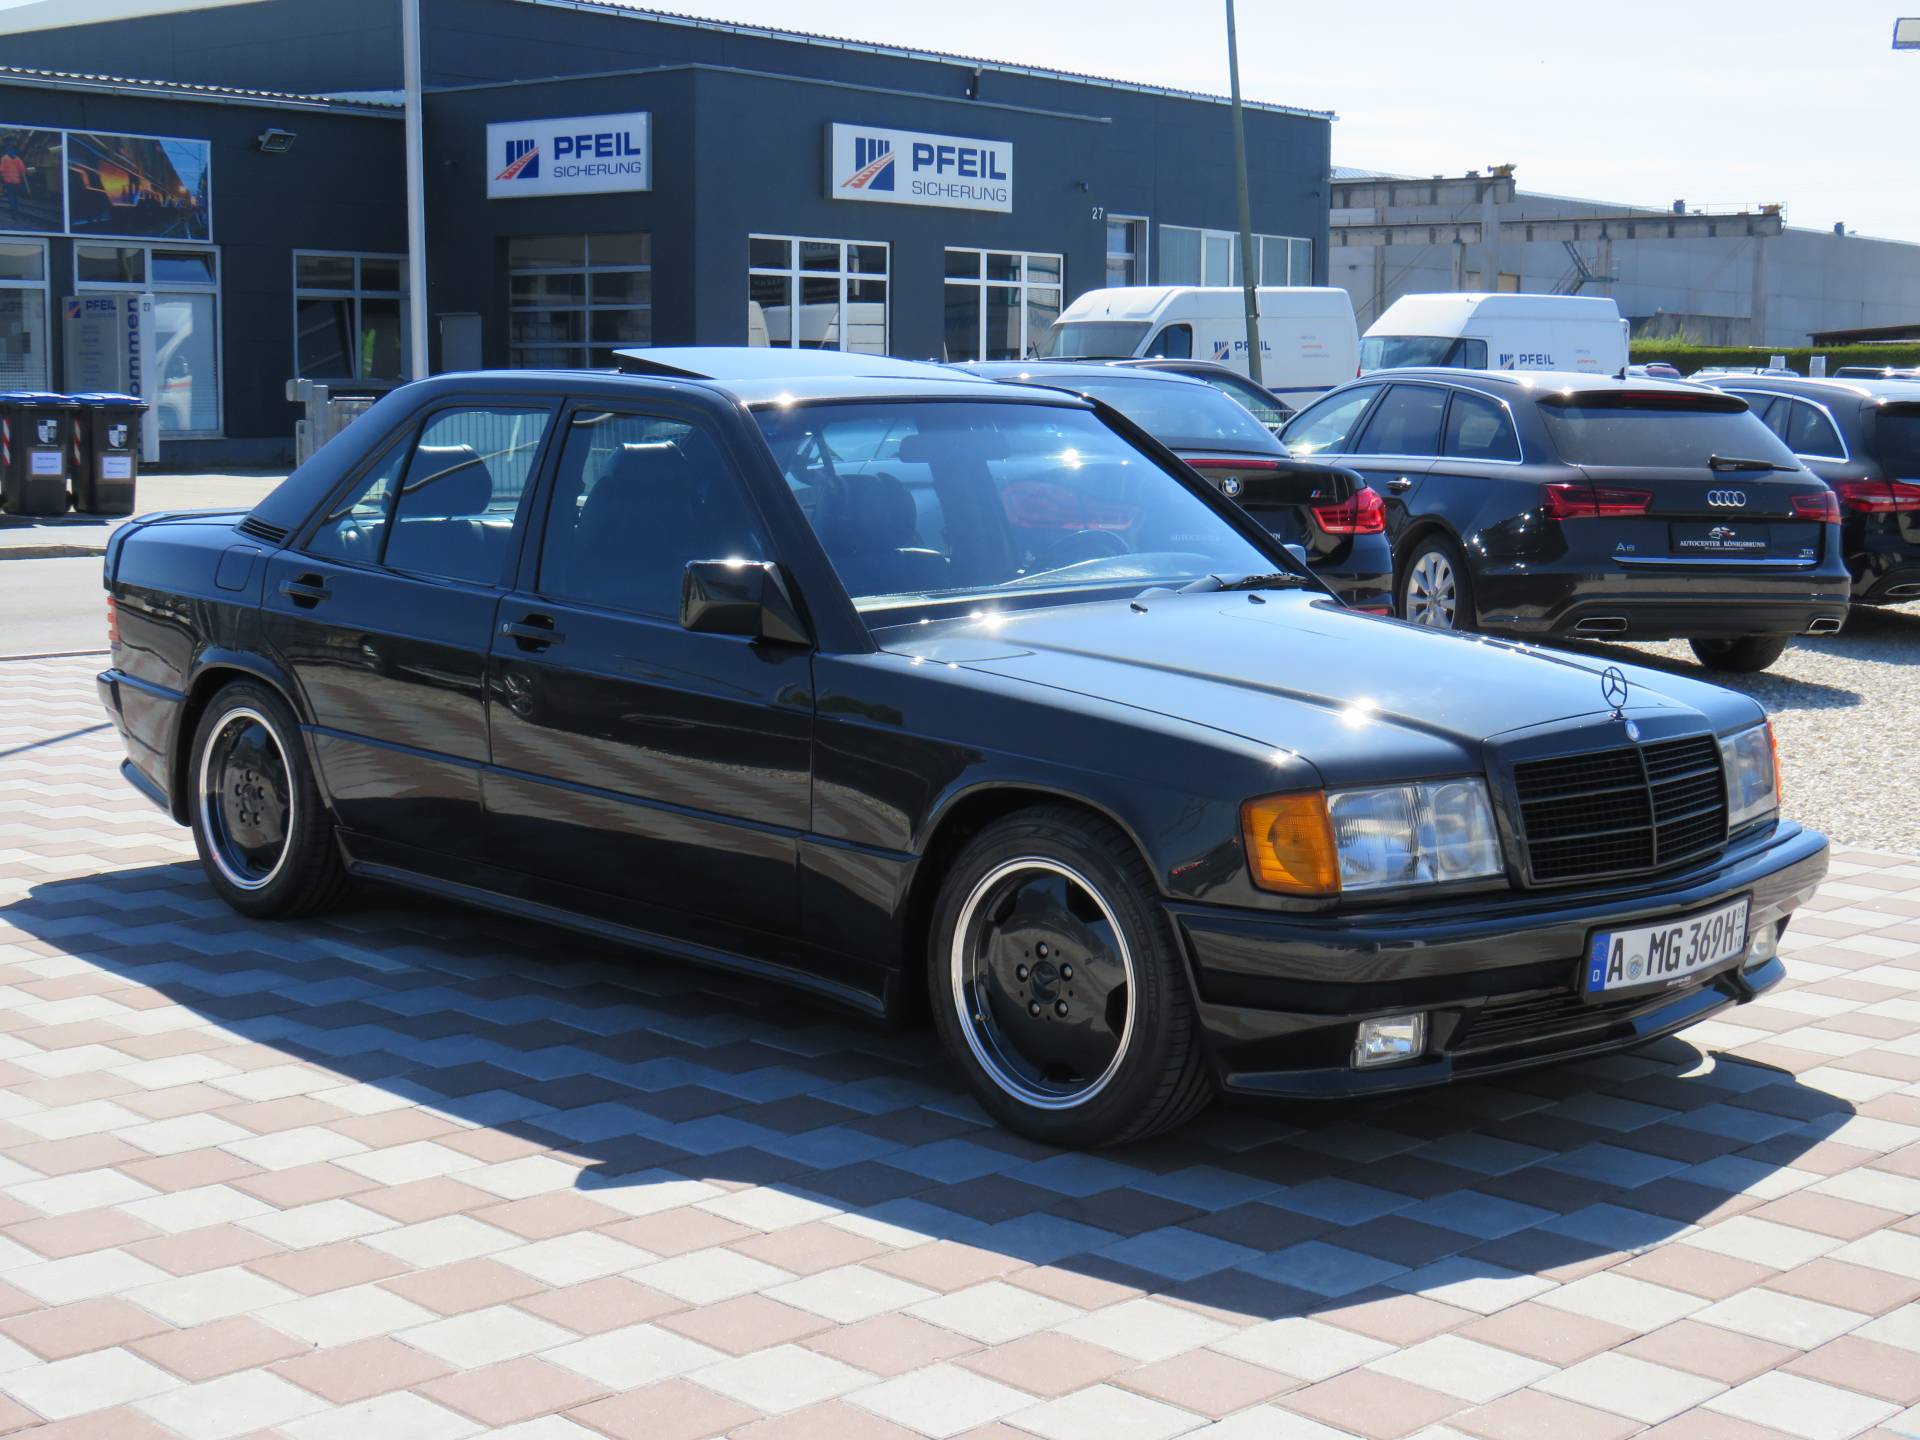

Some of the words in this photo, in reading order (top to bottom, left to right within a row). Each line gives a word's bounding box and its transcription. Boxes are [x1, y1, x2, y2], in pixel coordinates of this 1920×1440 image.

[553, 131, 641, 160] PFEIL
[912, 142, 1007, 181] PFEIL
[553, 161, 641, 178] SICHERUNG
[911, 180, 1008, 202] SICHERUNG
[1091, 207, 1104, 220] 27
[85, 300, 117, 311] PFEIL
[1234, 341, 1271, 351] PFIL
[1519, 353, 1555, 365] PFEIL
[1606, 937, 1624, 983] A
[1646, 927, 1683, 976] MG
[1687, 910, 1736, 966] 369H
[1592, 969, 1600, 982] D
